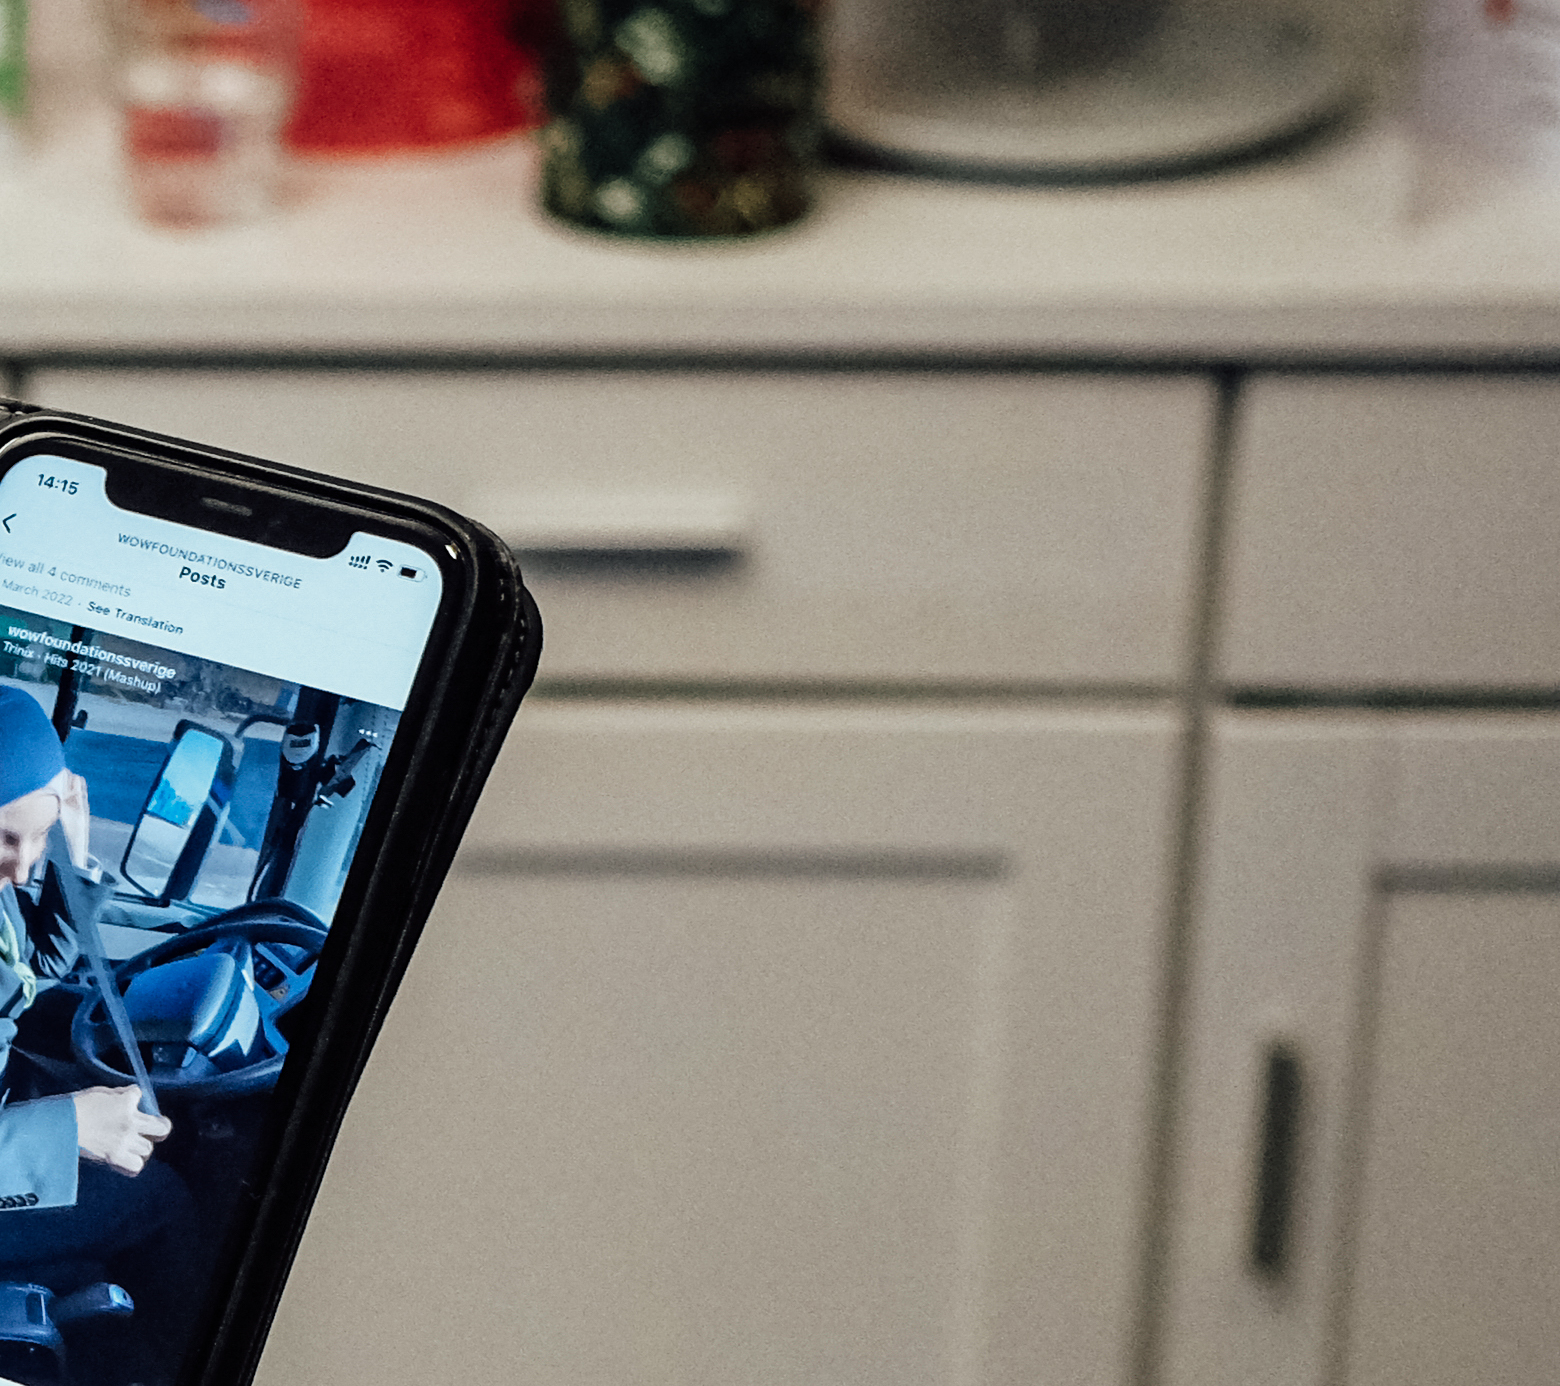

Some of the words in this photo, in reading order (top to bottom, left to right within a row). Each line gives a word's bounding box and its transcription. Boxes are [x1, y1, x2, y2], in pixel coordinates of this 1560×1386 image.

[37, 473, 80, 496] 14:15
[27, 561, 45, 575] all
[46, 565, 58, 578] 4
[59, 570, 132, 599] comments
[117, 532, 303, 590] WOWFOUNDATIONSSVERIGE
[178, 565, 227, 590] Posts
[1, 577, 40, 599] March
[40, 589, 74, 608] 2022
[85, 600, 112, 617] See
[114, 607, 185, 636] Translation
[2, 639, 36, 660] Trinix
[42, 650, 70, 670] Hits
[69, 658, 102, 678] 2021
[102, 665, 162, 696] (Mashup)
[7, 624, 178, 681] wowfoundationssverige
